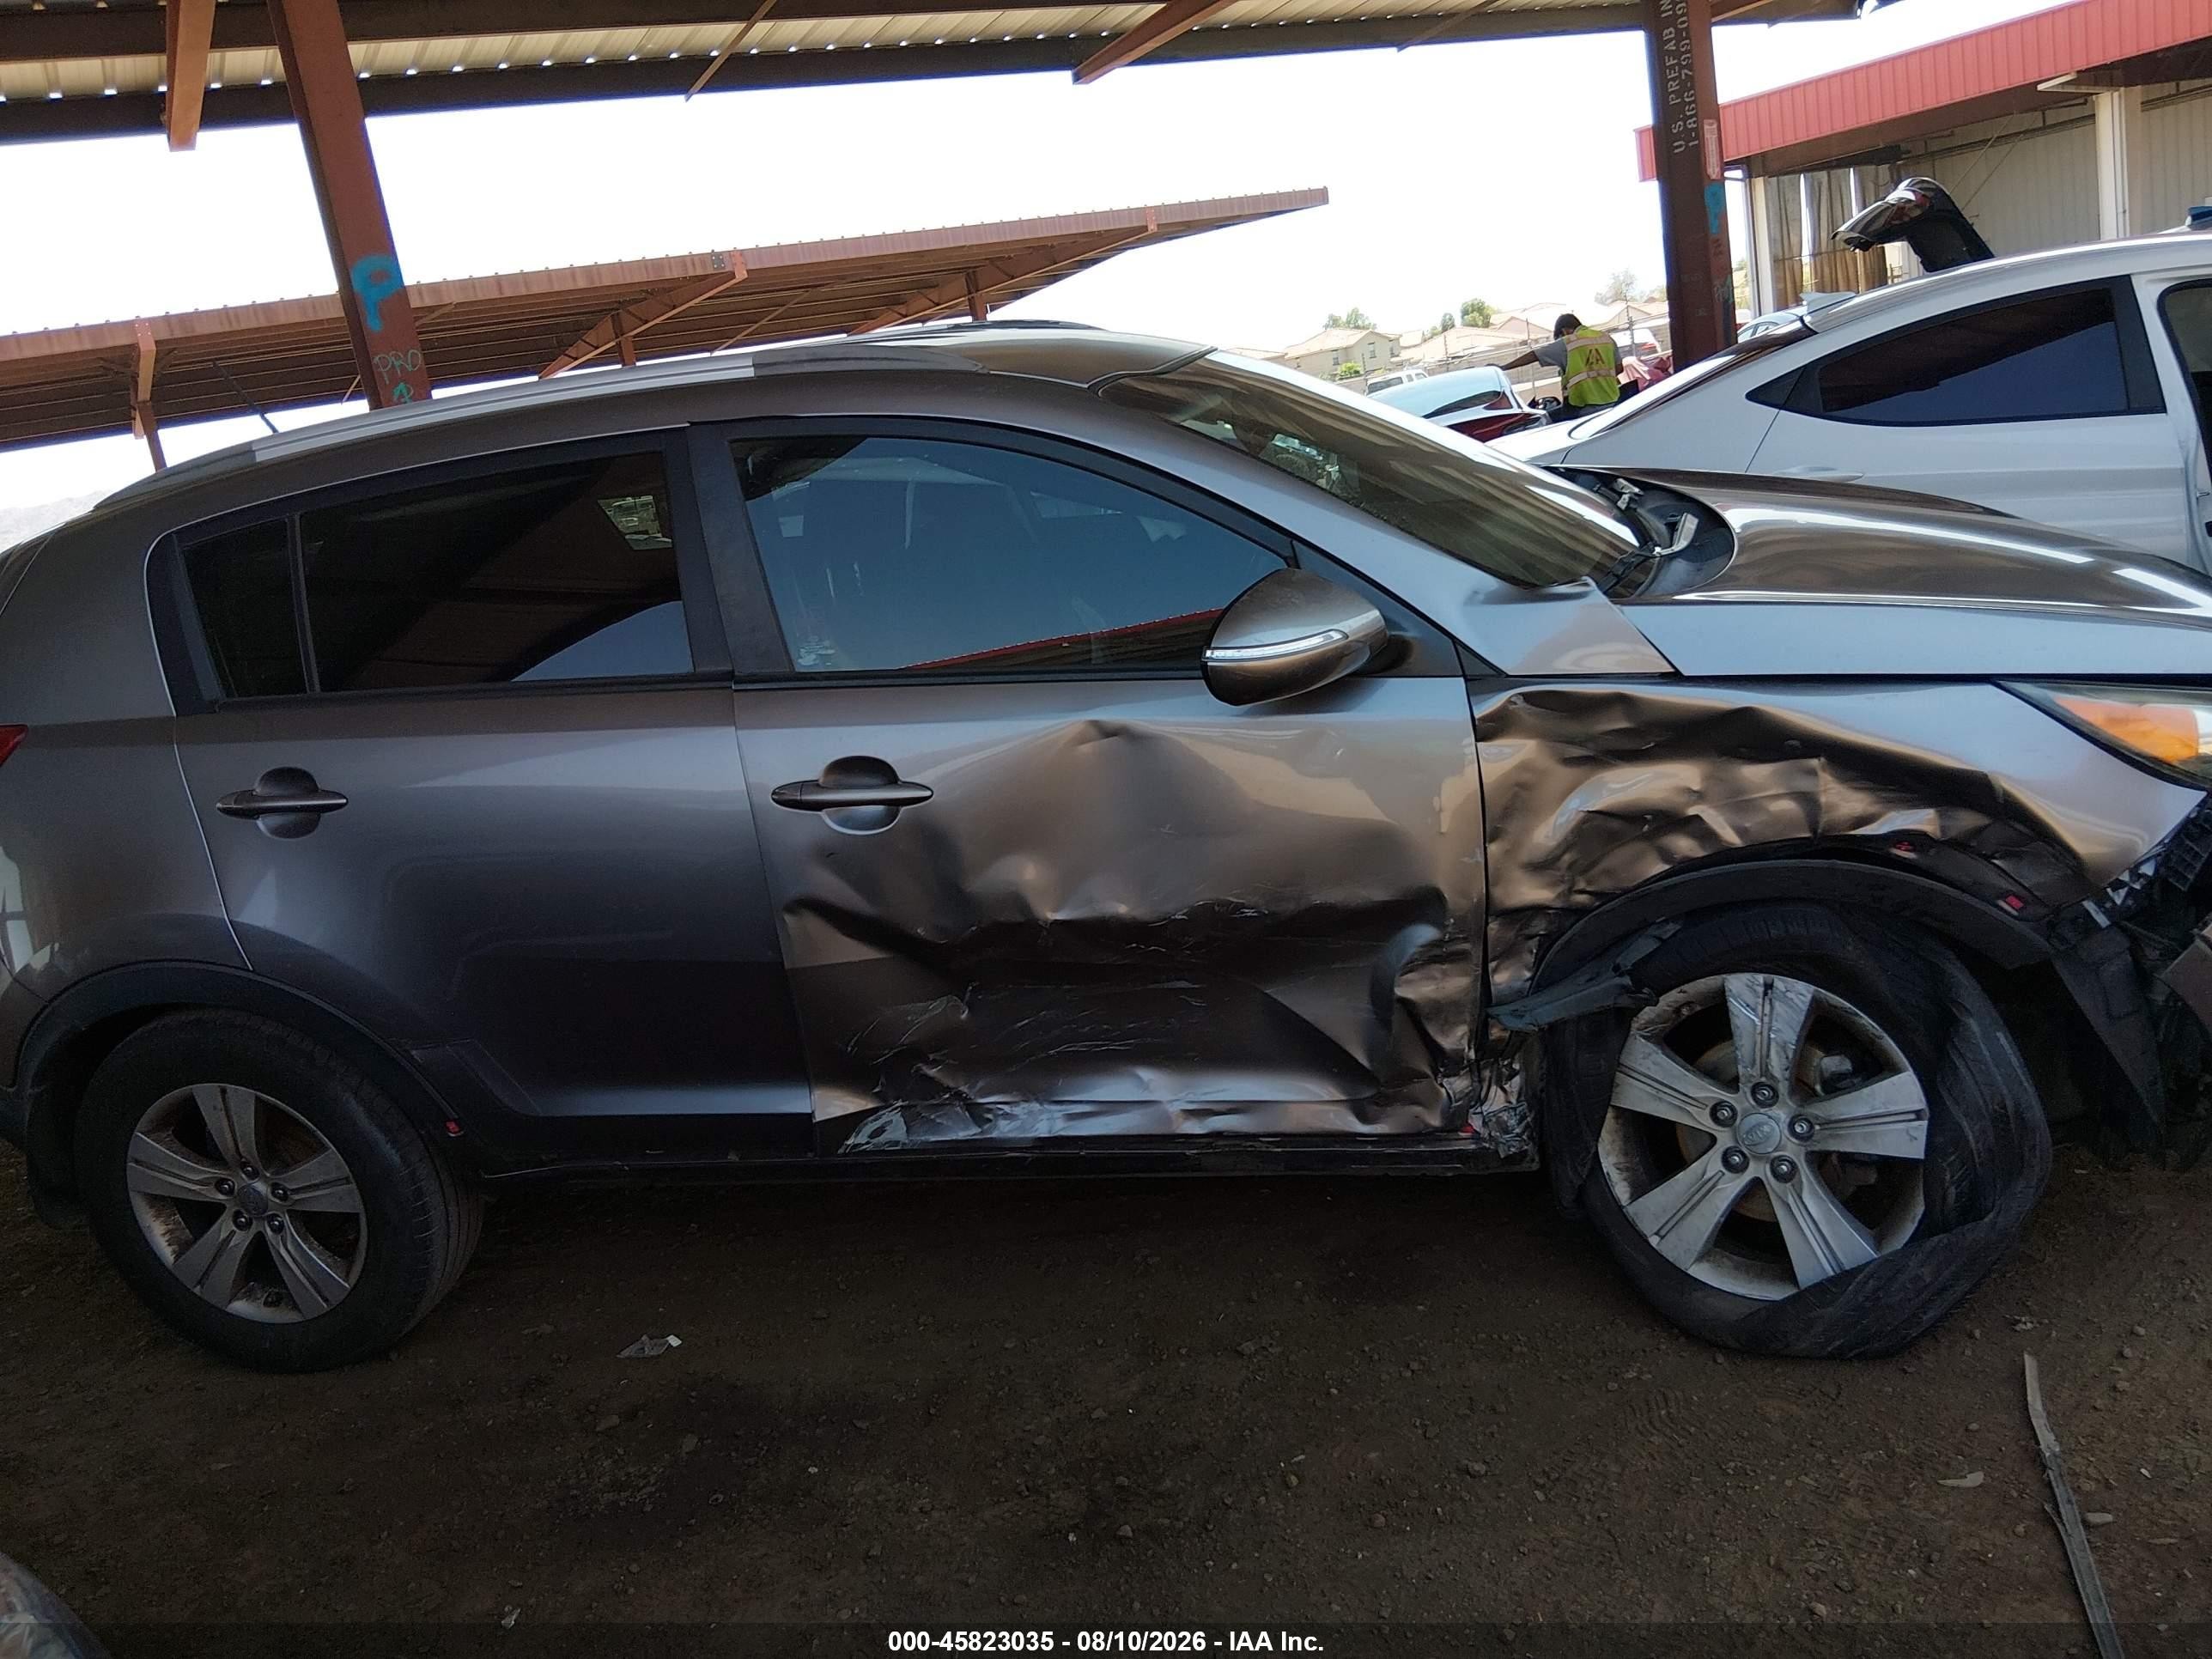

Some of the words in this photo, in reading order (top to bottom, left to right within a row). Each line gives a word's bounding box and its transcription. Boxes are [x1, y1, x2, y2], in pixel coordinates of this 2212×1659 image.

[1662, 27, 1681, 105] PREFAB
[1675, 0, 1698, 147] 1-866-799-09
[1672, 114, 1686, 153] U.S.
